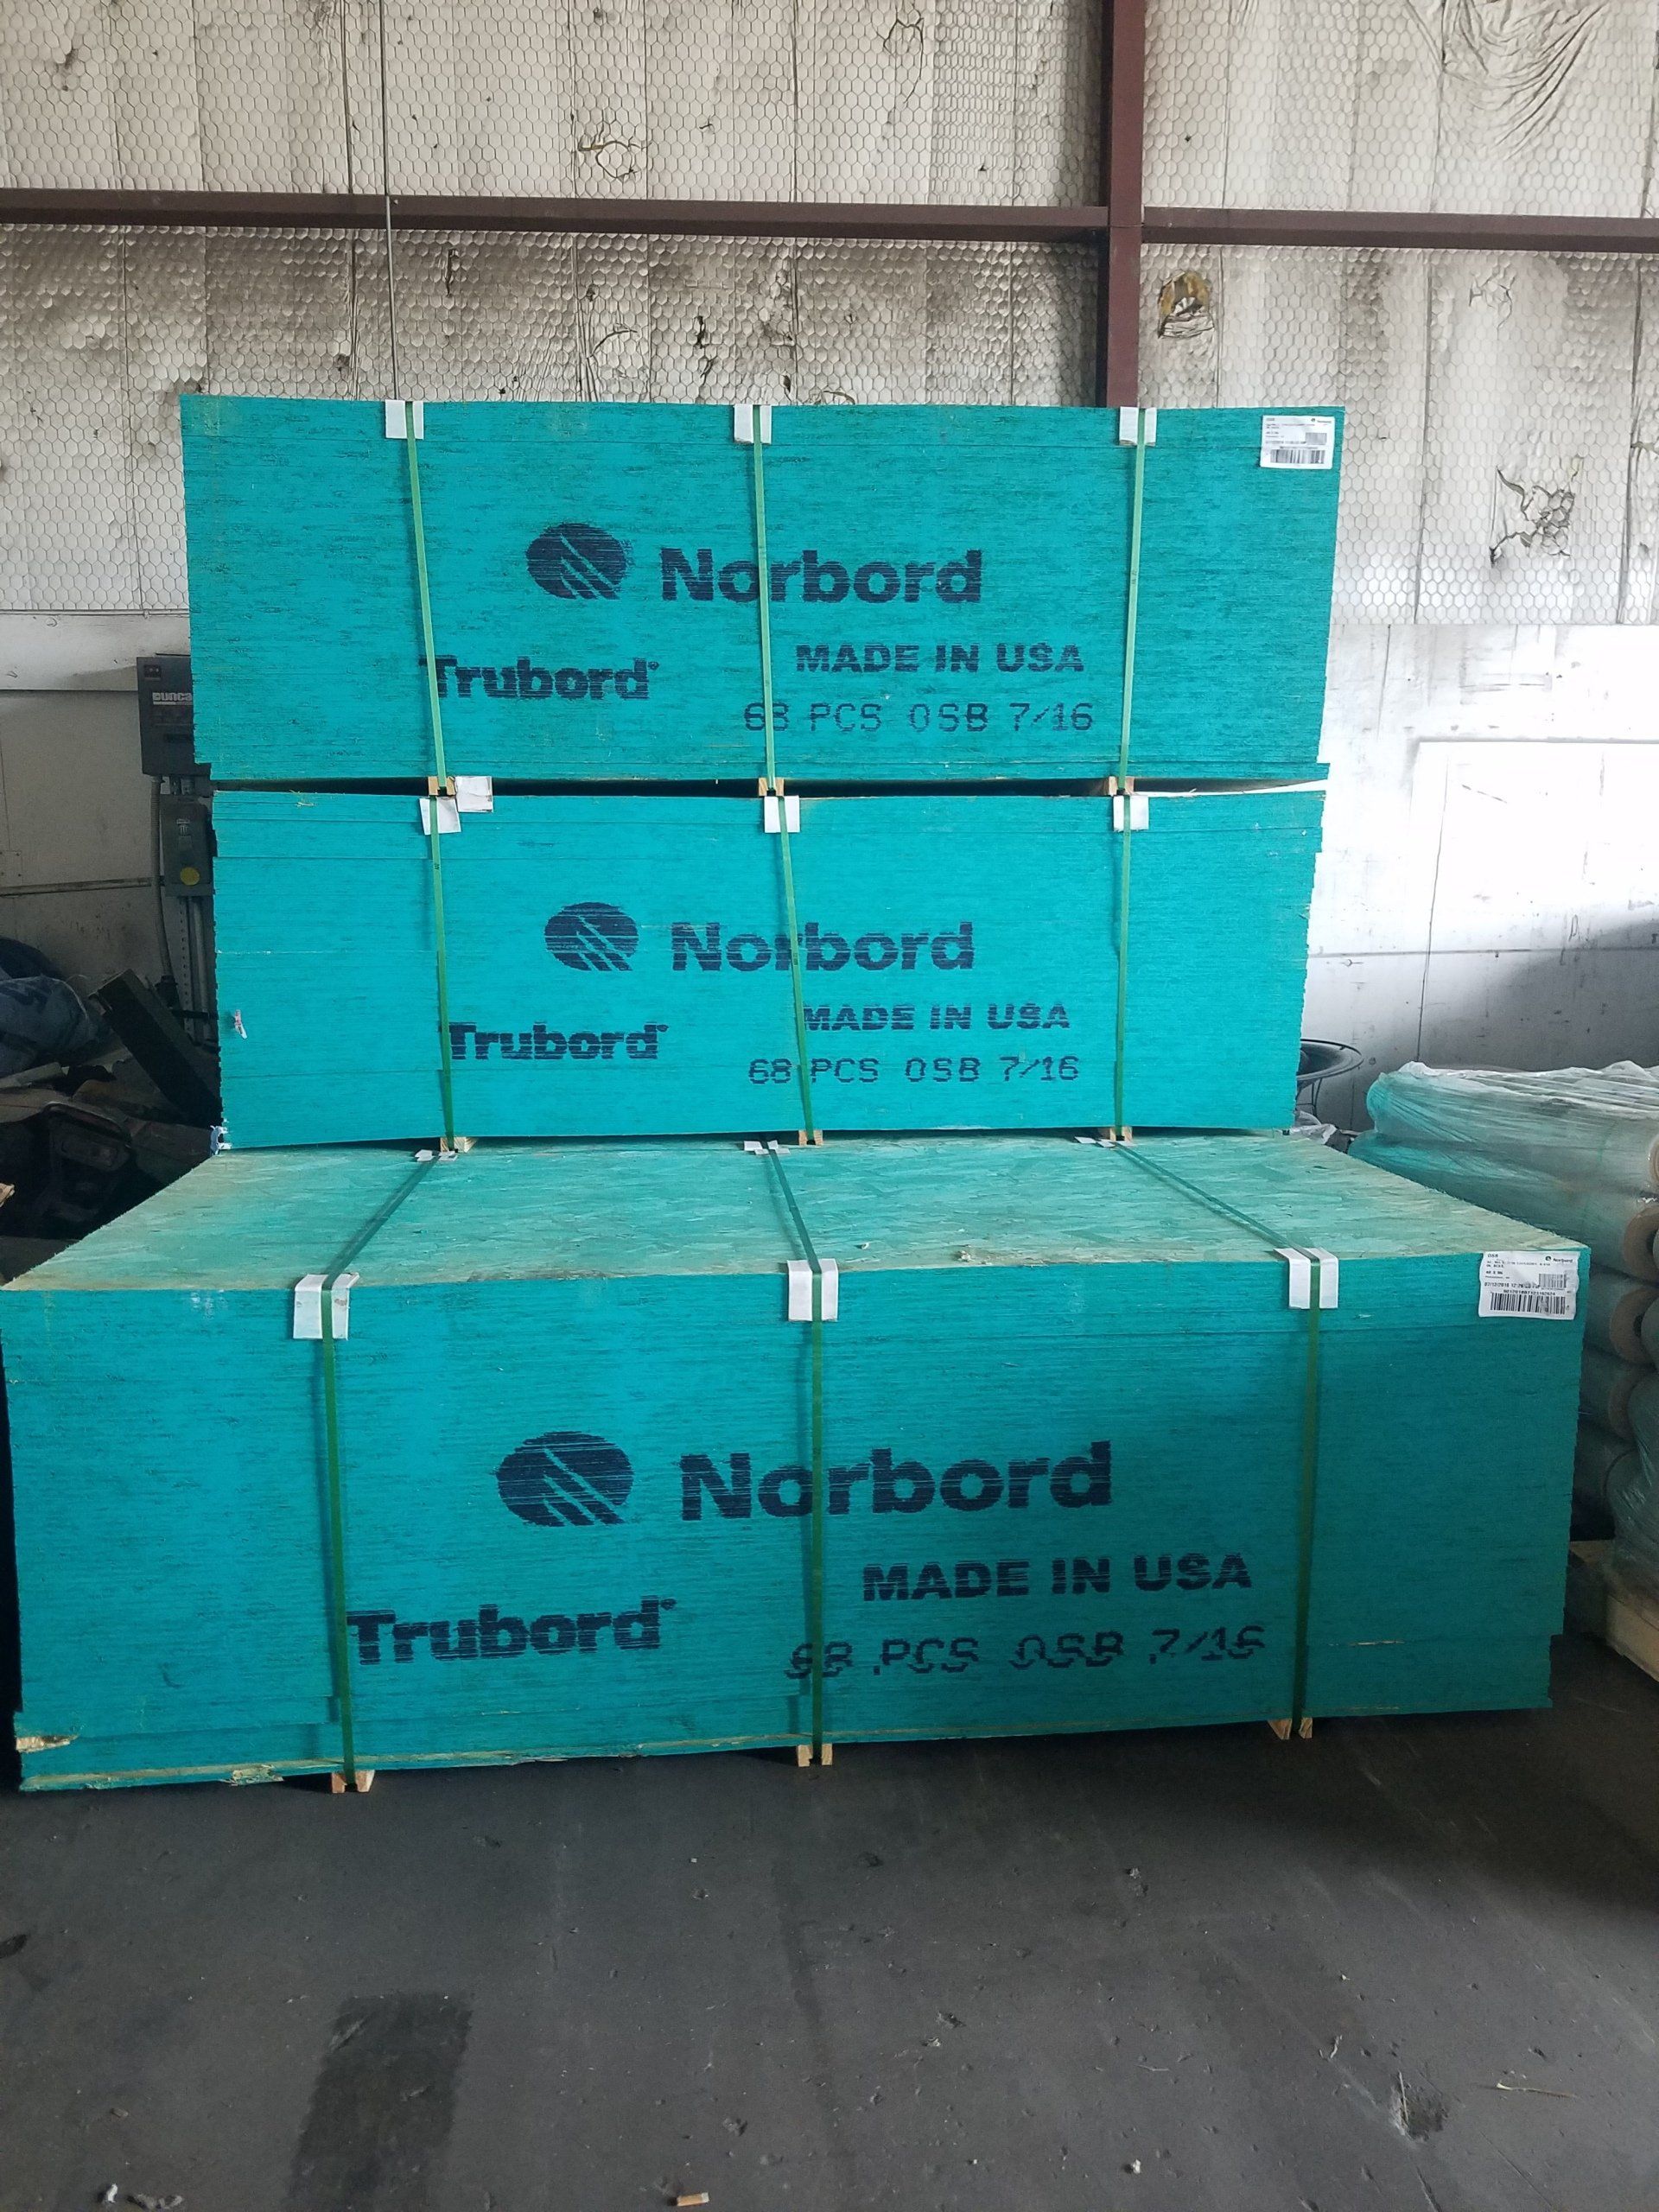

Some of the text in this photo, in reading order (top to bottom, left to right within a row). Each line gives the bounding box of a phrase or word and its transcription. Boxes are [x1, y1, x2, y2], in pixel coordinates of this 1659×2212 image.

[662, 548, 982, 603] Norbord
[795, 643, 1085, 673] MADE IN USA
[152, 692, 194, 702] Dunca
[744, 703, 790, 733] 68
[809, 703, 883, 733] PCS
[1011, 703, 1094, 733] 7/16
[671, 922, 974, 971] Norbord
[802, 1003, 1071, 1031] MADE IN USA
[748, 1059, 791, 1085] 68
[810, 1059, 880, 1085] PCS
[1000, 1058, 1079, 1085] 7/16
[678, 1440, 1111, 1521] Norbord
[862, 1552, 1252, 1601] MADE IN USA
[873, 1636, 980, 1676] PCS
[1149, 1624, 1266, 1664] 7/16
